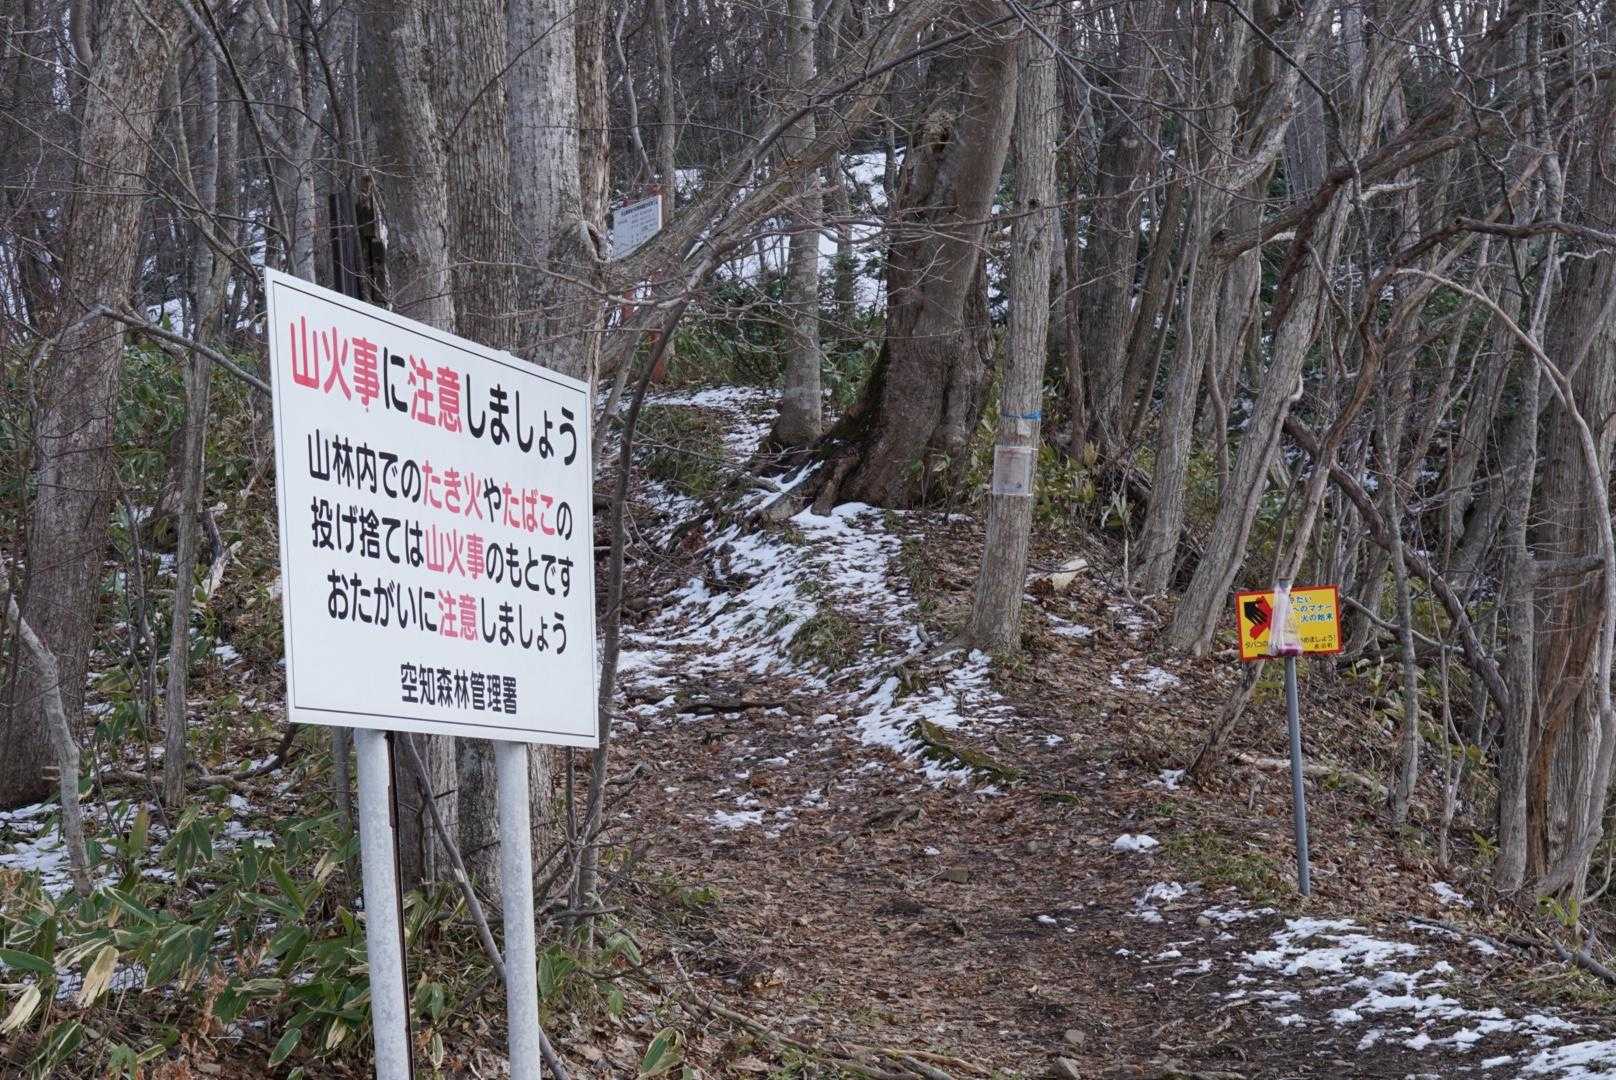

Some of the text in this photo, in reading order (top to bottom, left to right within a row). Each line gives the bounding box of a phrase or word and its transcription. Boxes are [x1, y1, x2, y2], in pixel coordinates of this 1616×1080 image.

[290, 316, 577, 466] 山火事に注意しましょう
[307, 428, 574, 541] 山林内でのたき火やたばこの
[310, 496, 575, 598] 投げ捨ては山火事のもとです
[327, 568, 568, 655] おたがいに注意しましょう
[400, 661, 517, 715] 空知森林管理署
